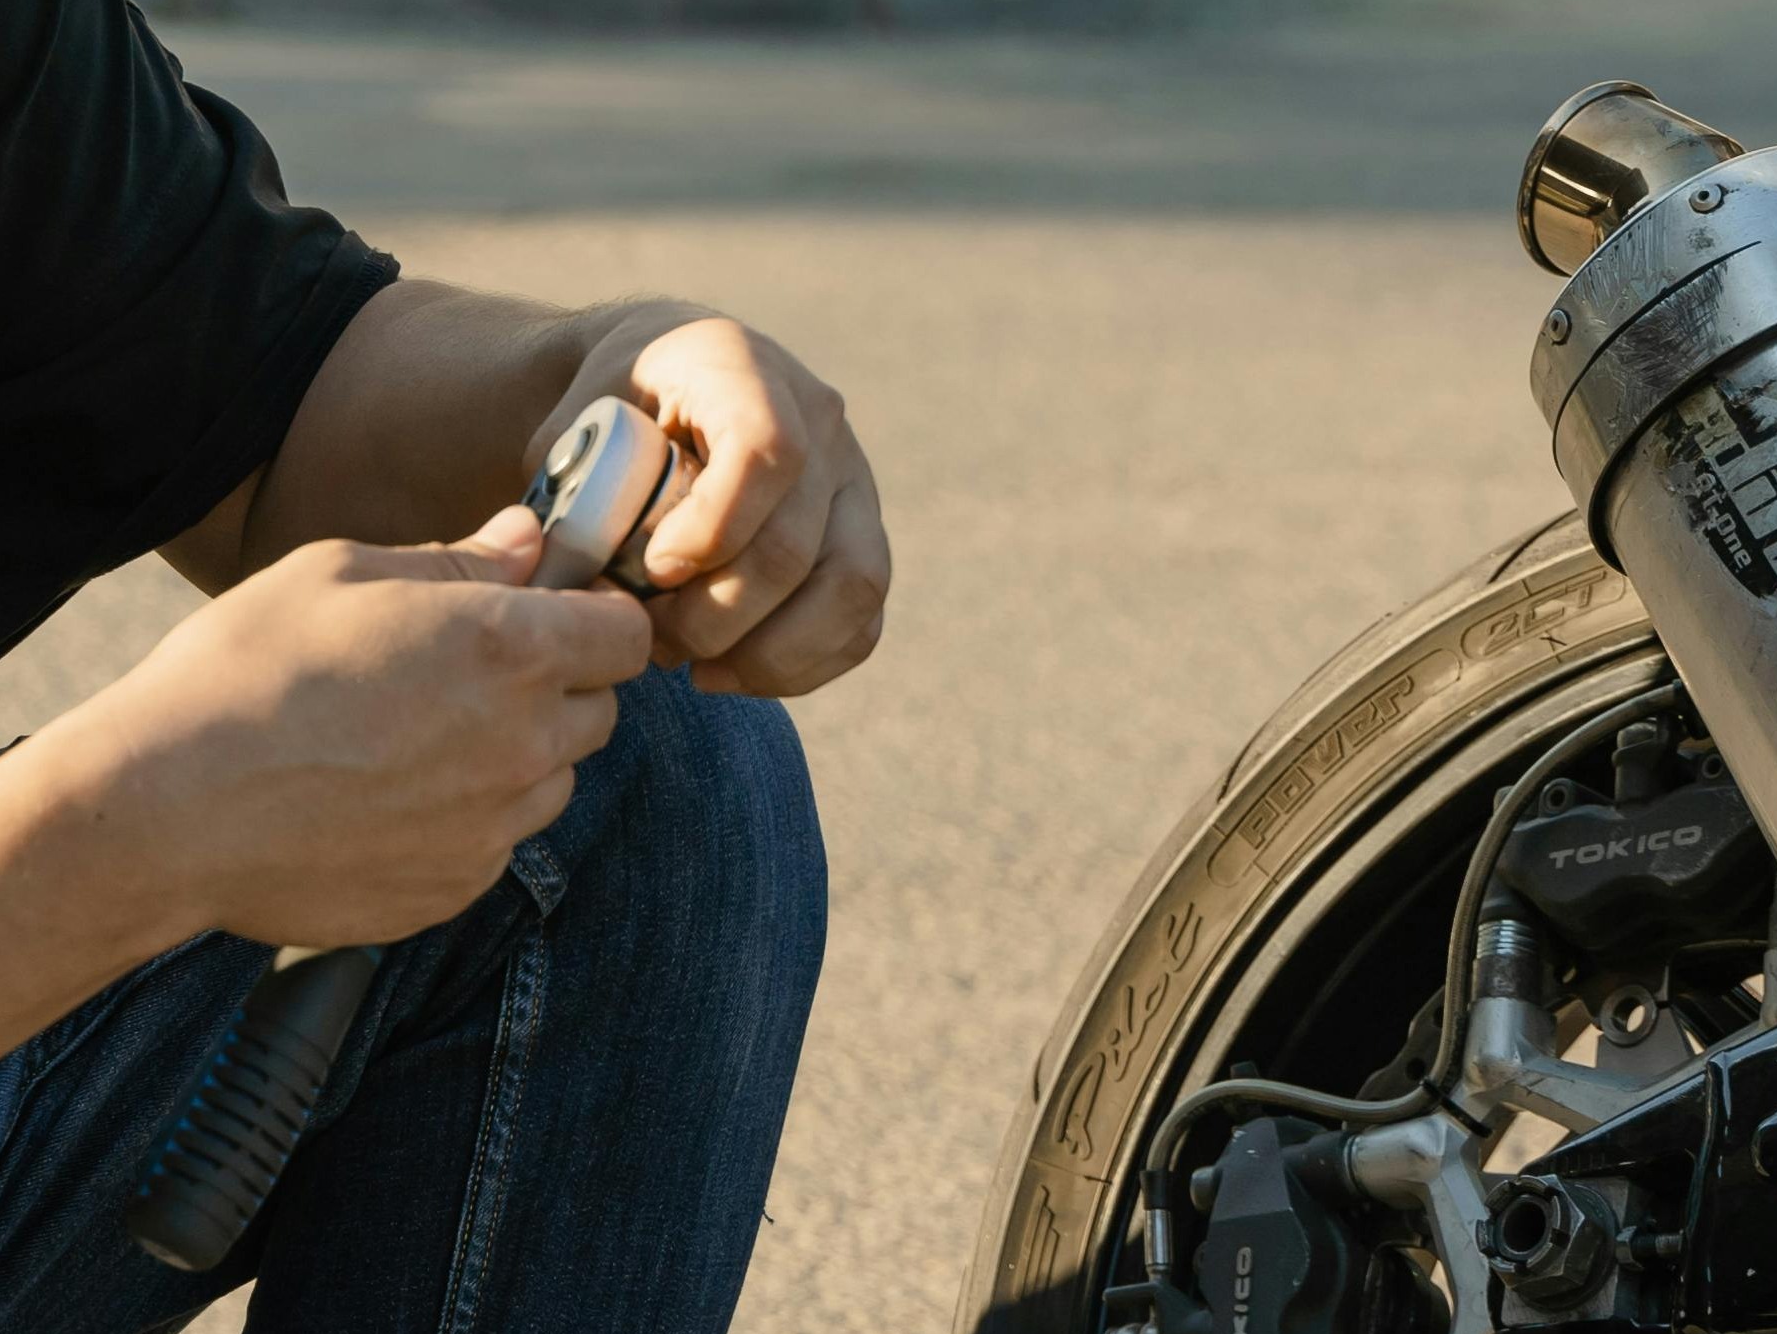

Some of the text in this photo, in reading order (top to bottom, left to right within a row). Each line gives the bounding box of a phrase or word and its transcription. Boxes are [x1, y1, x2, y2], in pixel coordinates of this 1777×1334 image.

[1052, 901, 1204, 1161] Pilot
[1482, 570, 1608, 657] 2CT
[1548, 824, 1704, 869] TOKICO
